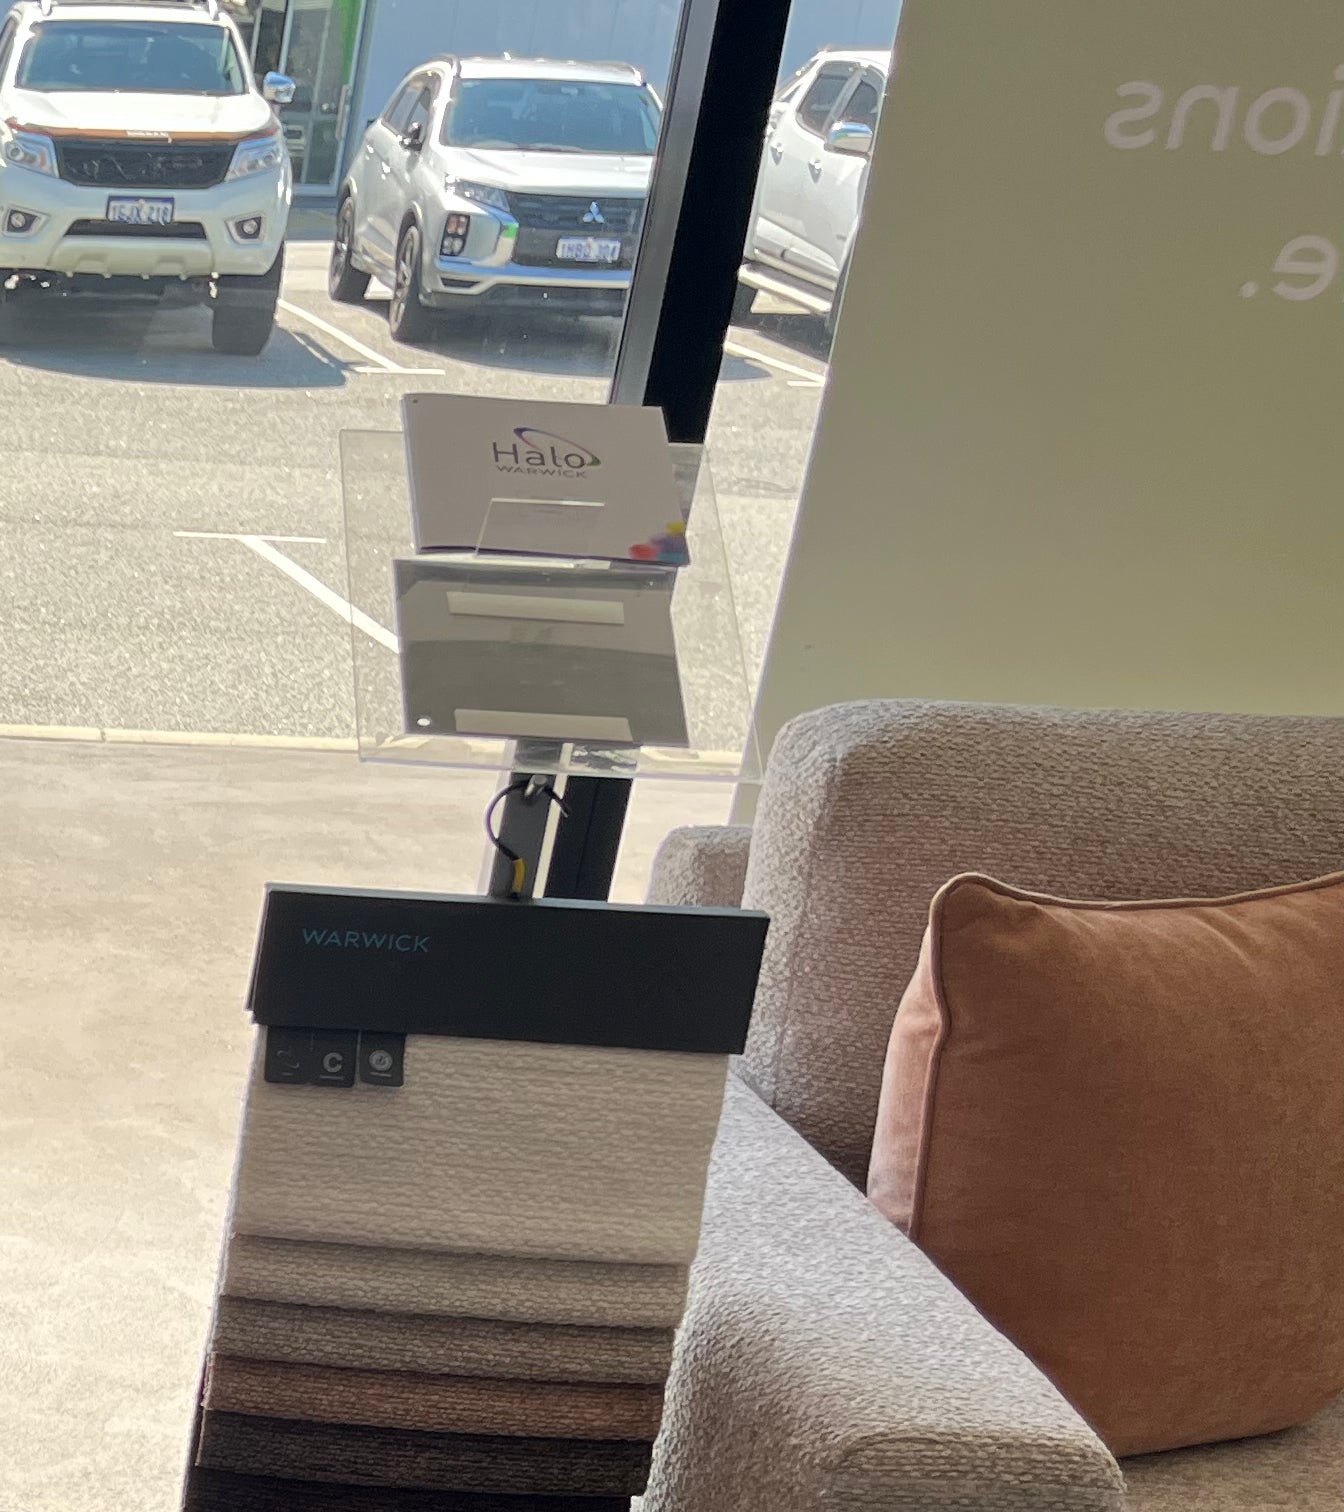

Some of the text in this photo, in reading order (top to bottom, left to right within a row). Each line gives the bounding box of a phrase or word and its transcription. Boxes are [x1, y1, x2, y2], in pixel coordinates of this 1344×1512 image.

[492, 442, 585, 470] Halo
[496, 465, 588, 479] WARWICK
[302, 928, 431, 954] WARWICK
